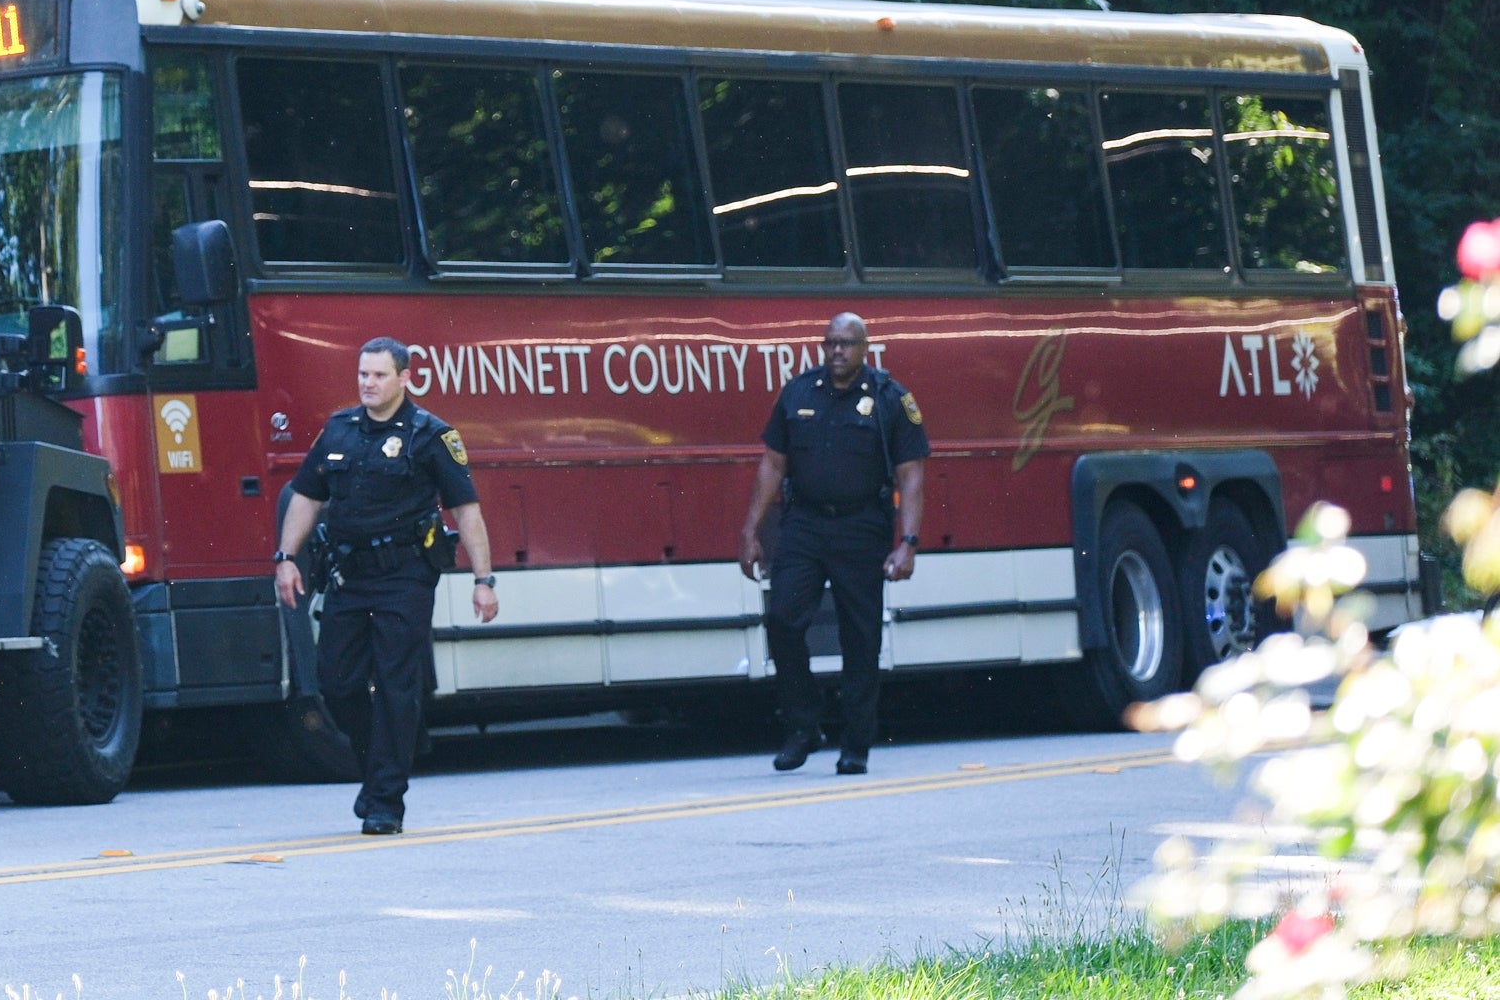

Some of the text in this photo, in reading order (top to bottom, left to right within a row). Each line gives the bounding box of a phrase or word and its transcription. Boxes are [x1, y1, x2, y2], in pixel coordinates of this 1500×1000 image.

[404, 344, 886, 397] GWINNETT COUNTY TRAT
